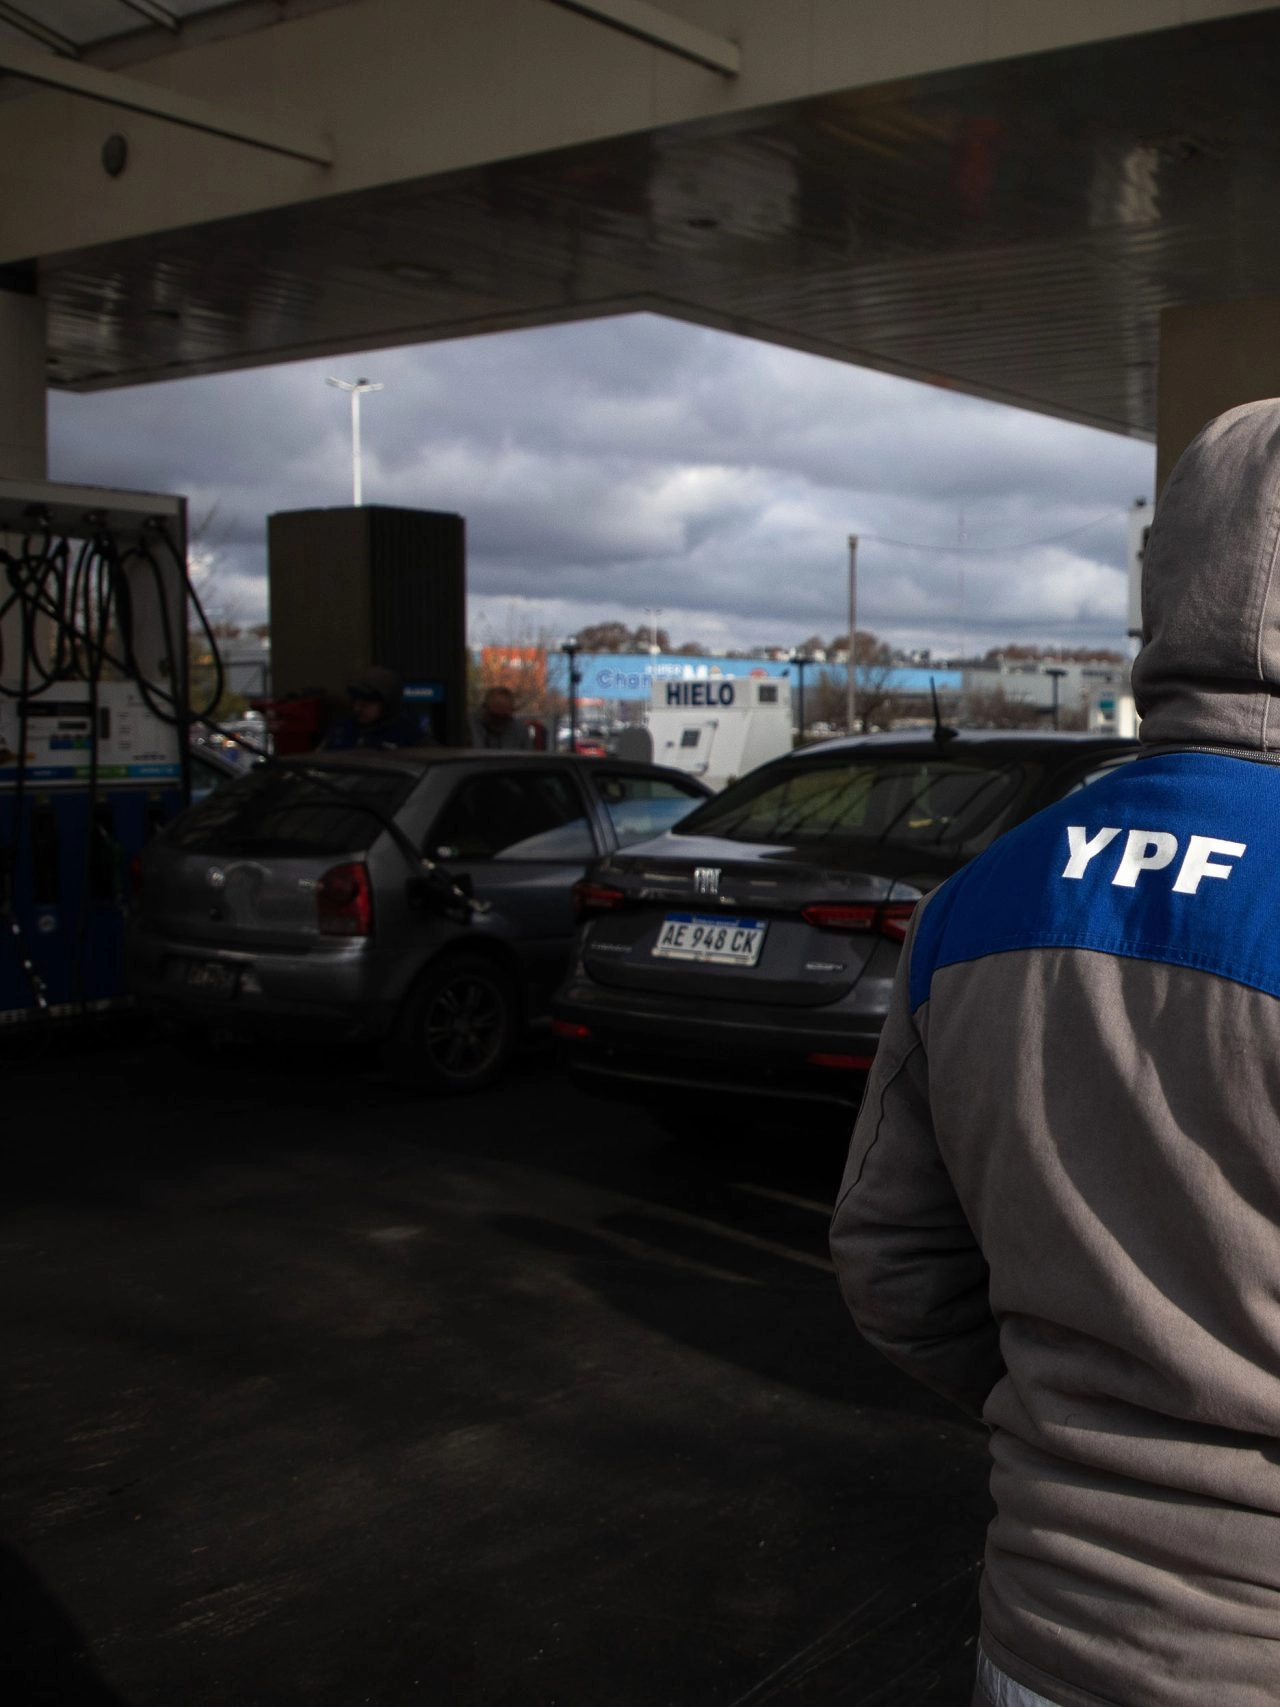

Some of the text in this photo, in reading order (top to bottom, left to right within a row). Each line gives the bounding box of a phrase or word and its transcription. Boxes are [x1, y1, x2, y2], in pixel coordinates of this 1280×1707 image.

[667, 682, 735, 705] HIELO
[1061, 825, 1247, 894] YPF
[662, 924, 757, 953] AE 948 CK
